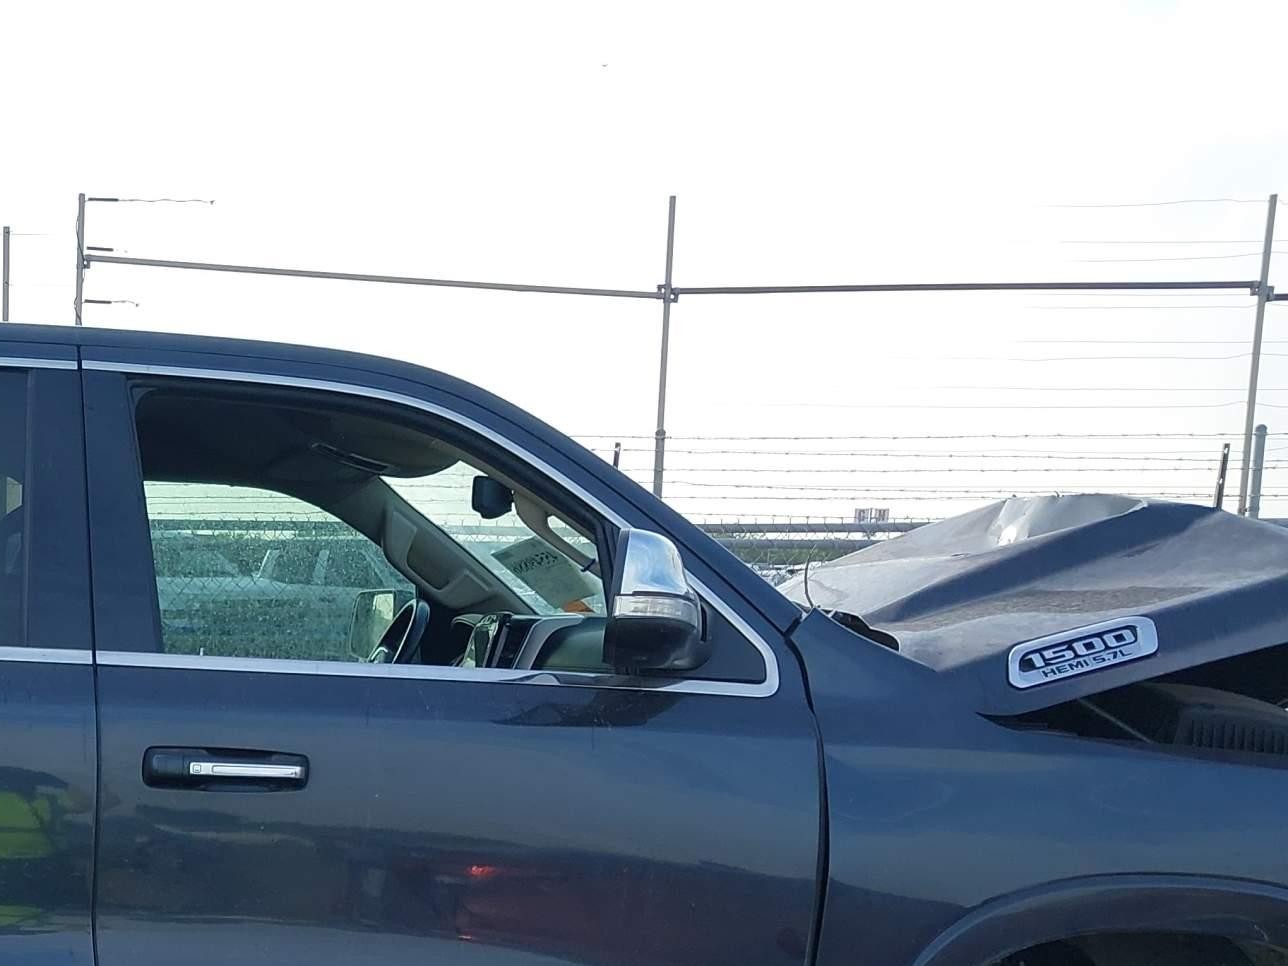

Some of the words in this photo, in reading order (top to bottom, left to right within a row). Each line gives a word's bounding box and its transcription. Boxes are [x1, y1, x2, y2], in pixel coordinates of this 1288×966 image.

[1023, 628, 1136, 668] 1500
[1042, 660, 1090, 678] HEMI
[1093, 649, 1133, 664] 5.7L
